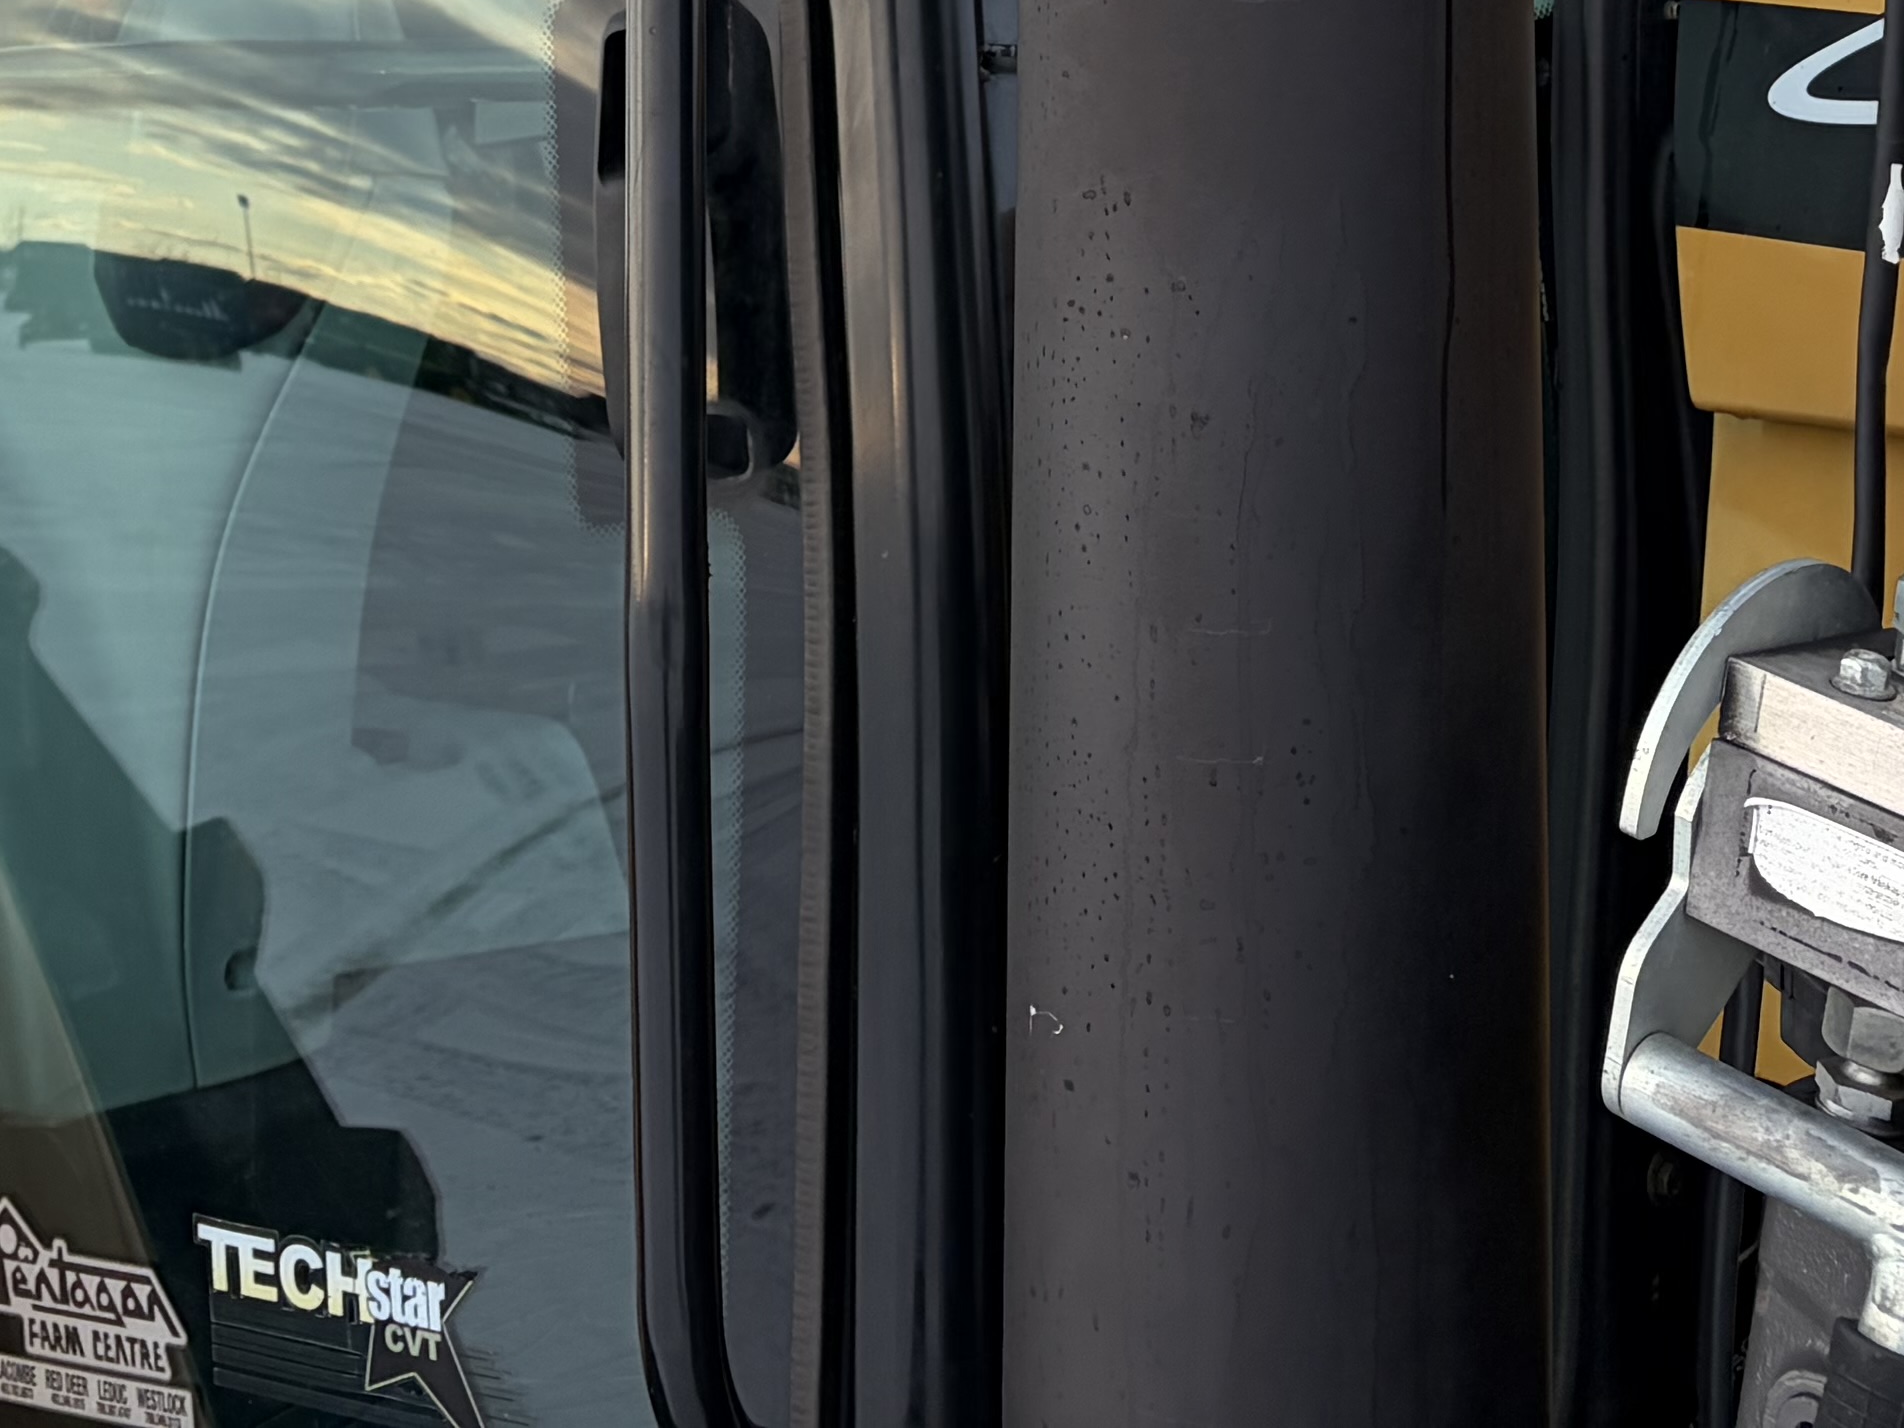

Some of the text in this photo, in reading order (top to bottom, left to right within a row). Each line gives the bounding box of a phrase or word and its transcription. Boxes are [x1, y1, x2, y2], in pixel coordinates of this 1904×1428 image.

[29, 1318, 166, 1373] FARM CENTRE
[384, 1323, 442, 1362] CVT
[136, 1387, 188, 1417] WESTLOCK
